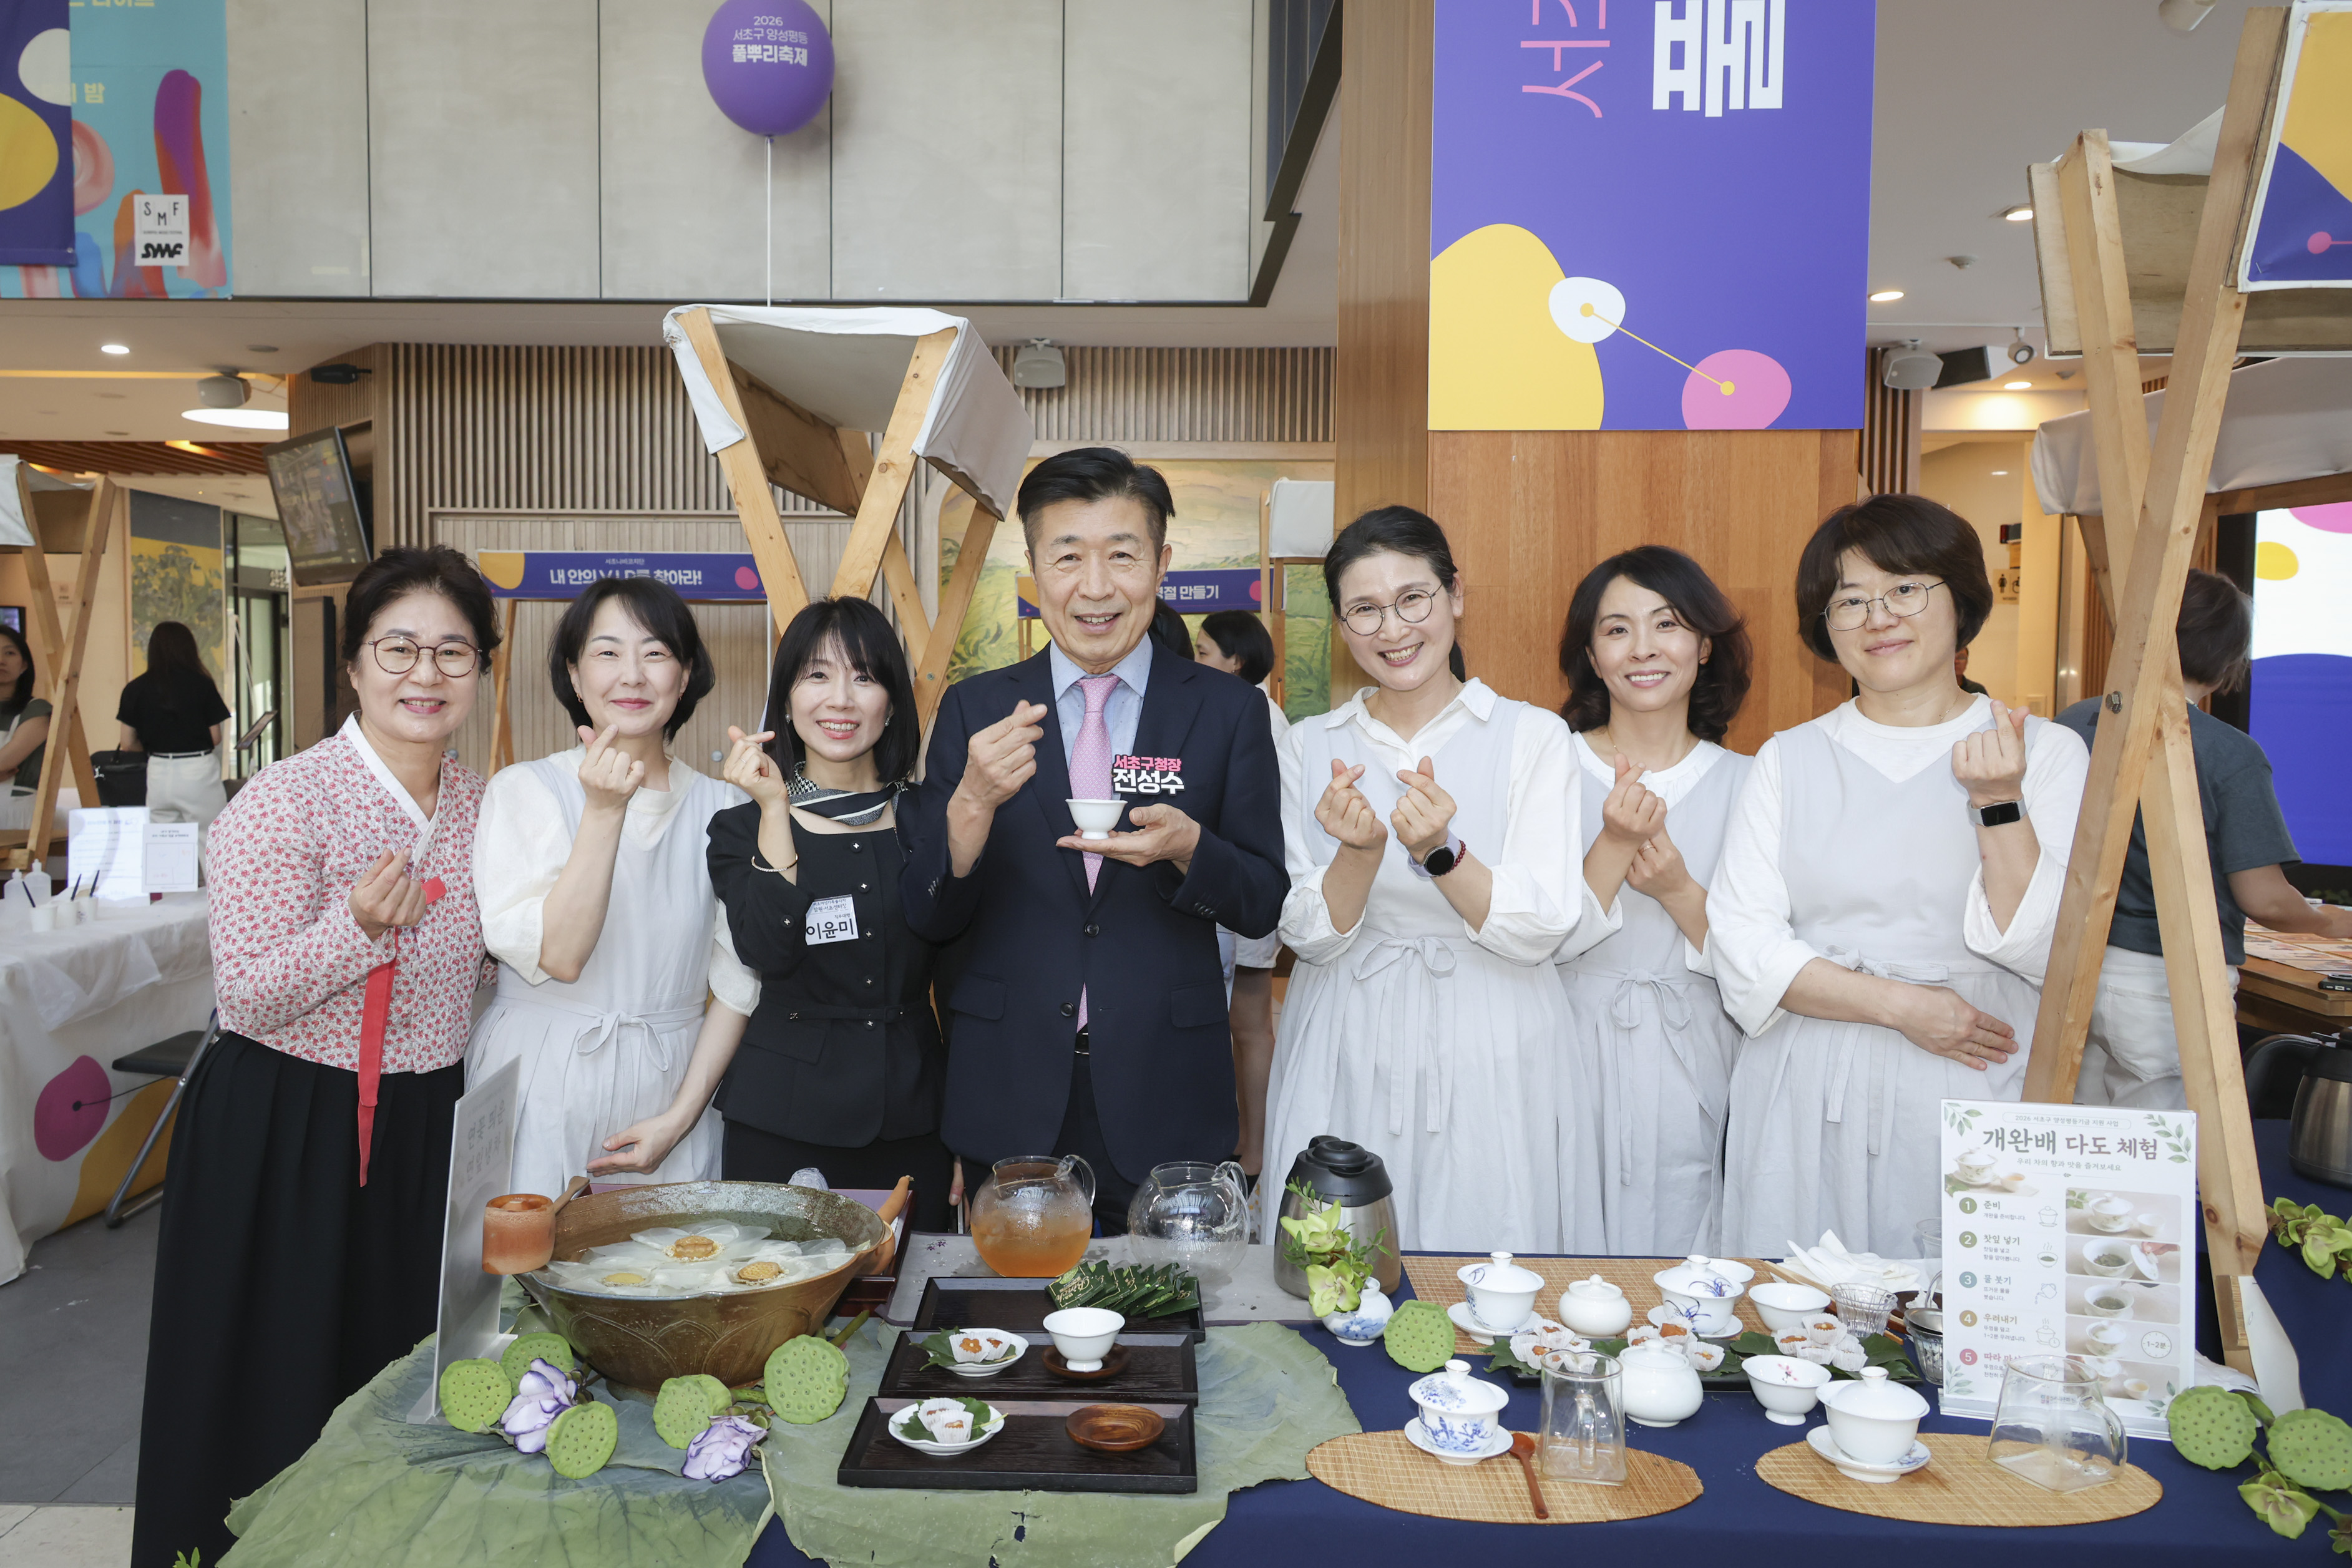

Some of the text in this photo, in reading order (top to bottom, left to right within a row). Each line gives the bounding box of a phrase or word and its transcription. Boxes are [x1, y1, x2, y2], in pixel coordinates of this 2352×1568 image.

[753, 16, 783, 26] 2026
[733, 28, 808, 44] 서초구 양성평등
[732, 44, 808, 67] 풀뿌리축제
[84, 83, 105, 104] 밤
[550, 569, 565, 585] 내
[567, 569, 597, 585] 안의
[653, 568, 703, 585] 찾아라!
[1179, 585, 1219, 600] 만들기
[1114, 755, 1182, 772] 서초구청장
[1113, 769, 1184, 794] 전성수
[806, 918, 854, 940] 이윤미
[2053, 1117, 2090, 1126] 양성평등기금
[1983, 1127, 2157, 1160] 개완배 다도 체험
[2084, 1162, 2122, 1171] 즐겨보세요
[1965, 1200, 2001, 1210] 1 준비
[1964, 1234, 2020, 1245] 2 찻잎 넣기
[1964, 1274, 2011, 1285] 3 물 붓기
[1964, 1313, 1972, 1323] 4
[1965, 1352, 1972, 1362] 5
[1984, 1352, 2001, 1361] 따라
